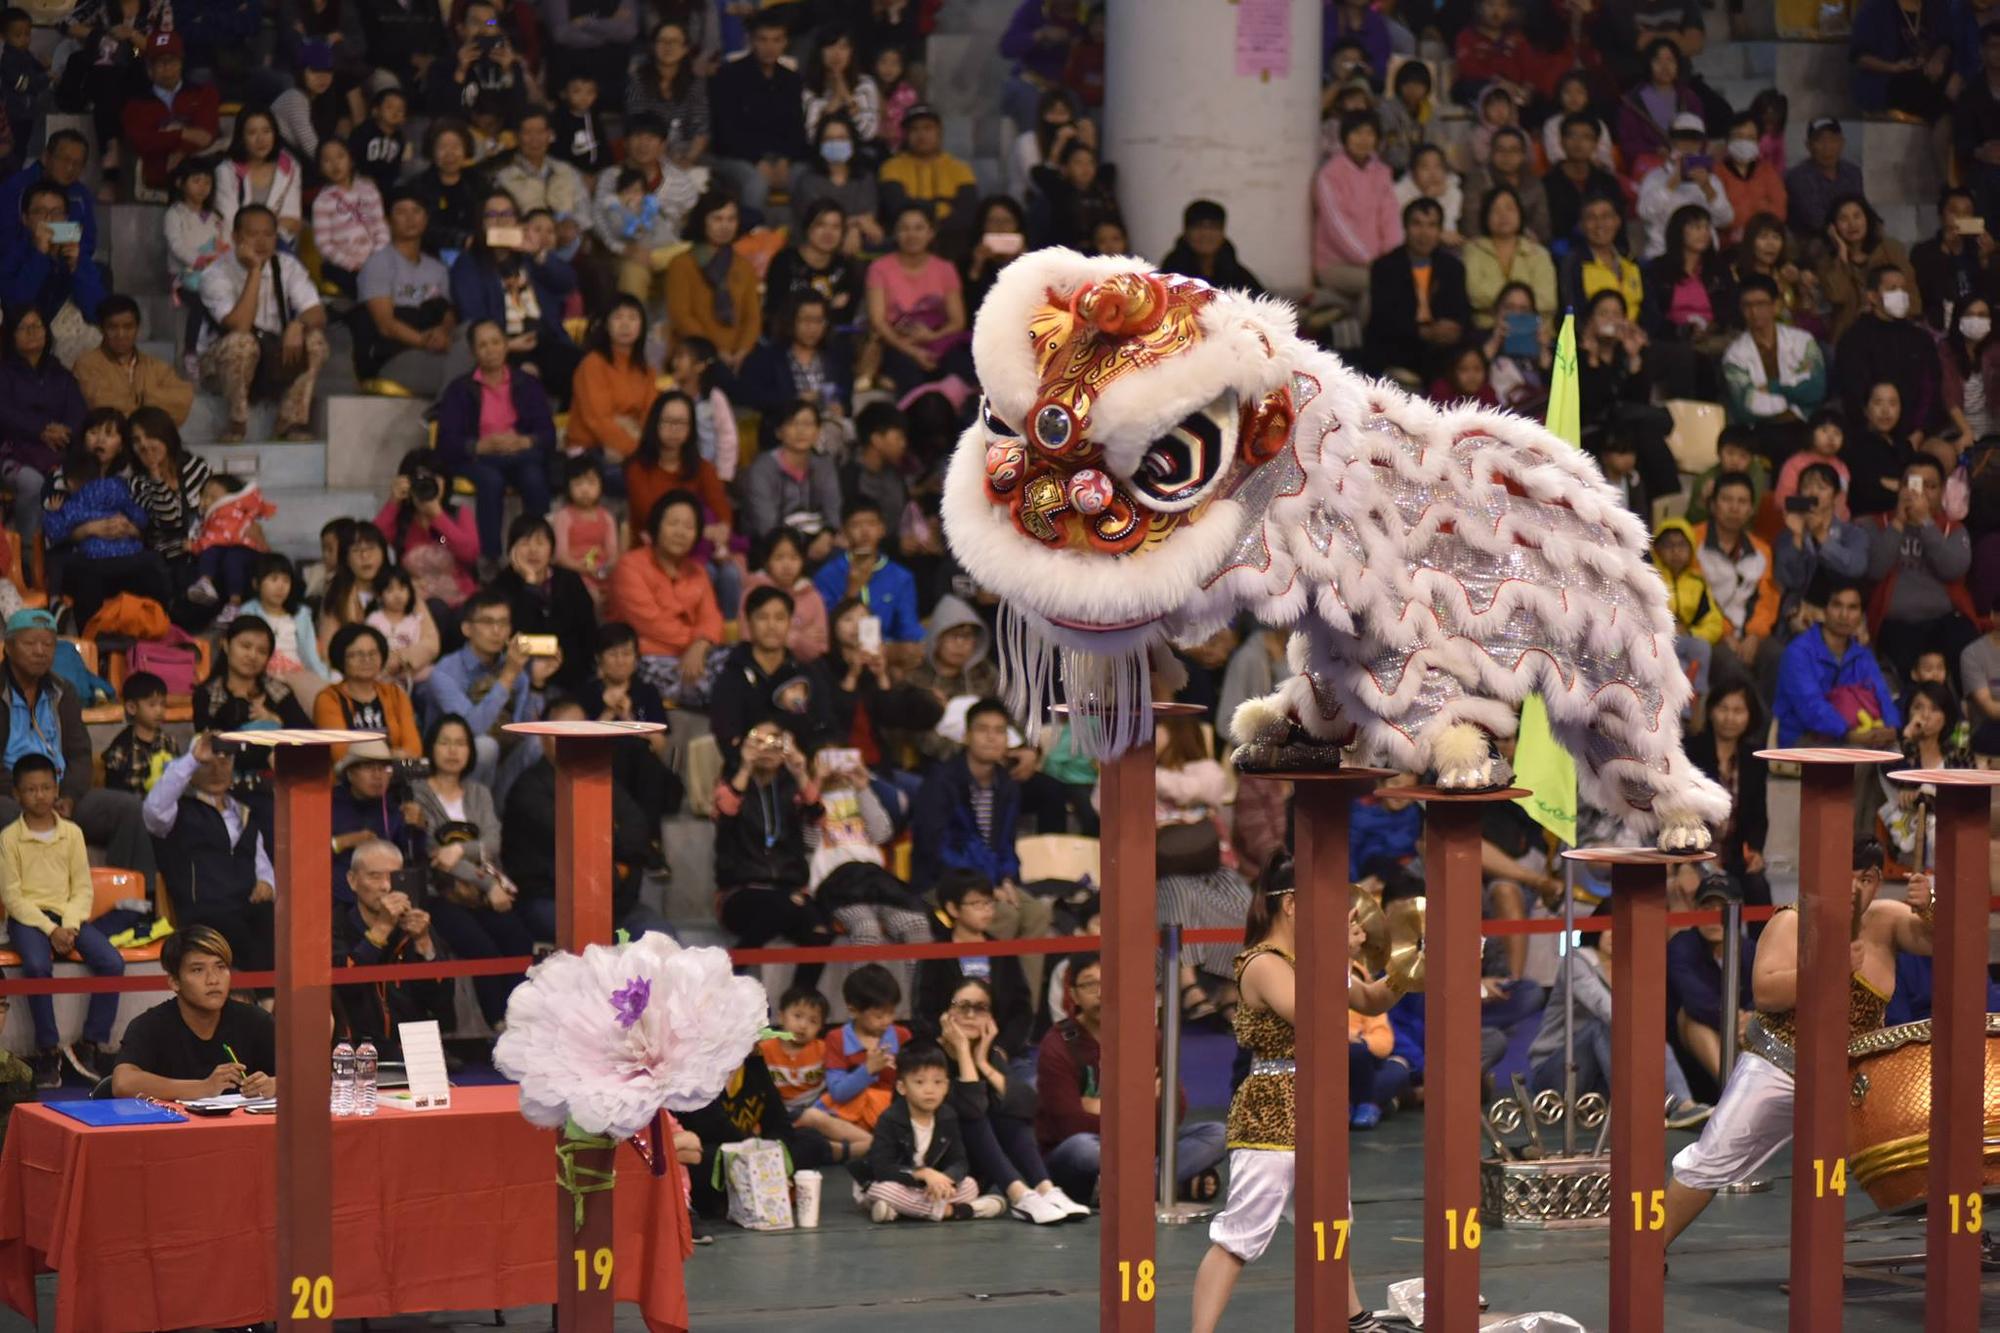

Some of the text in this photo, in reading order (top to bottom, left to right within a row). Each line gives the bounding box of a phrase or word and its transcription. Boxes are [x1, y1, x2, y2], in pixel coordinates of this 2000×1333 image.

[1813, 1158, 1848, 1198] 14
[1445, 1207, 1482, 1250] 16
[1631, 1189, 1667, 1231] 15
[1948, 1192, 1983, 1235] 13
[1313, 1219, 1351, 1262] 17
[574, 1248, 614, 1291] 19
[1118, 1259, 1156, 1302] 18
[291, 1275, 334, 1319] 20
